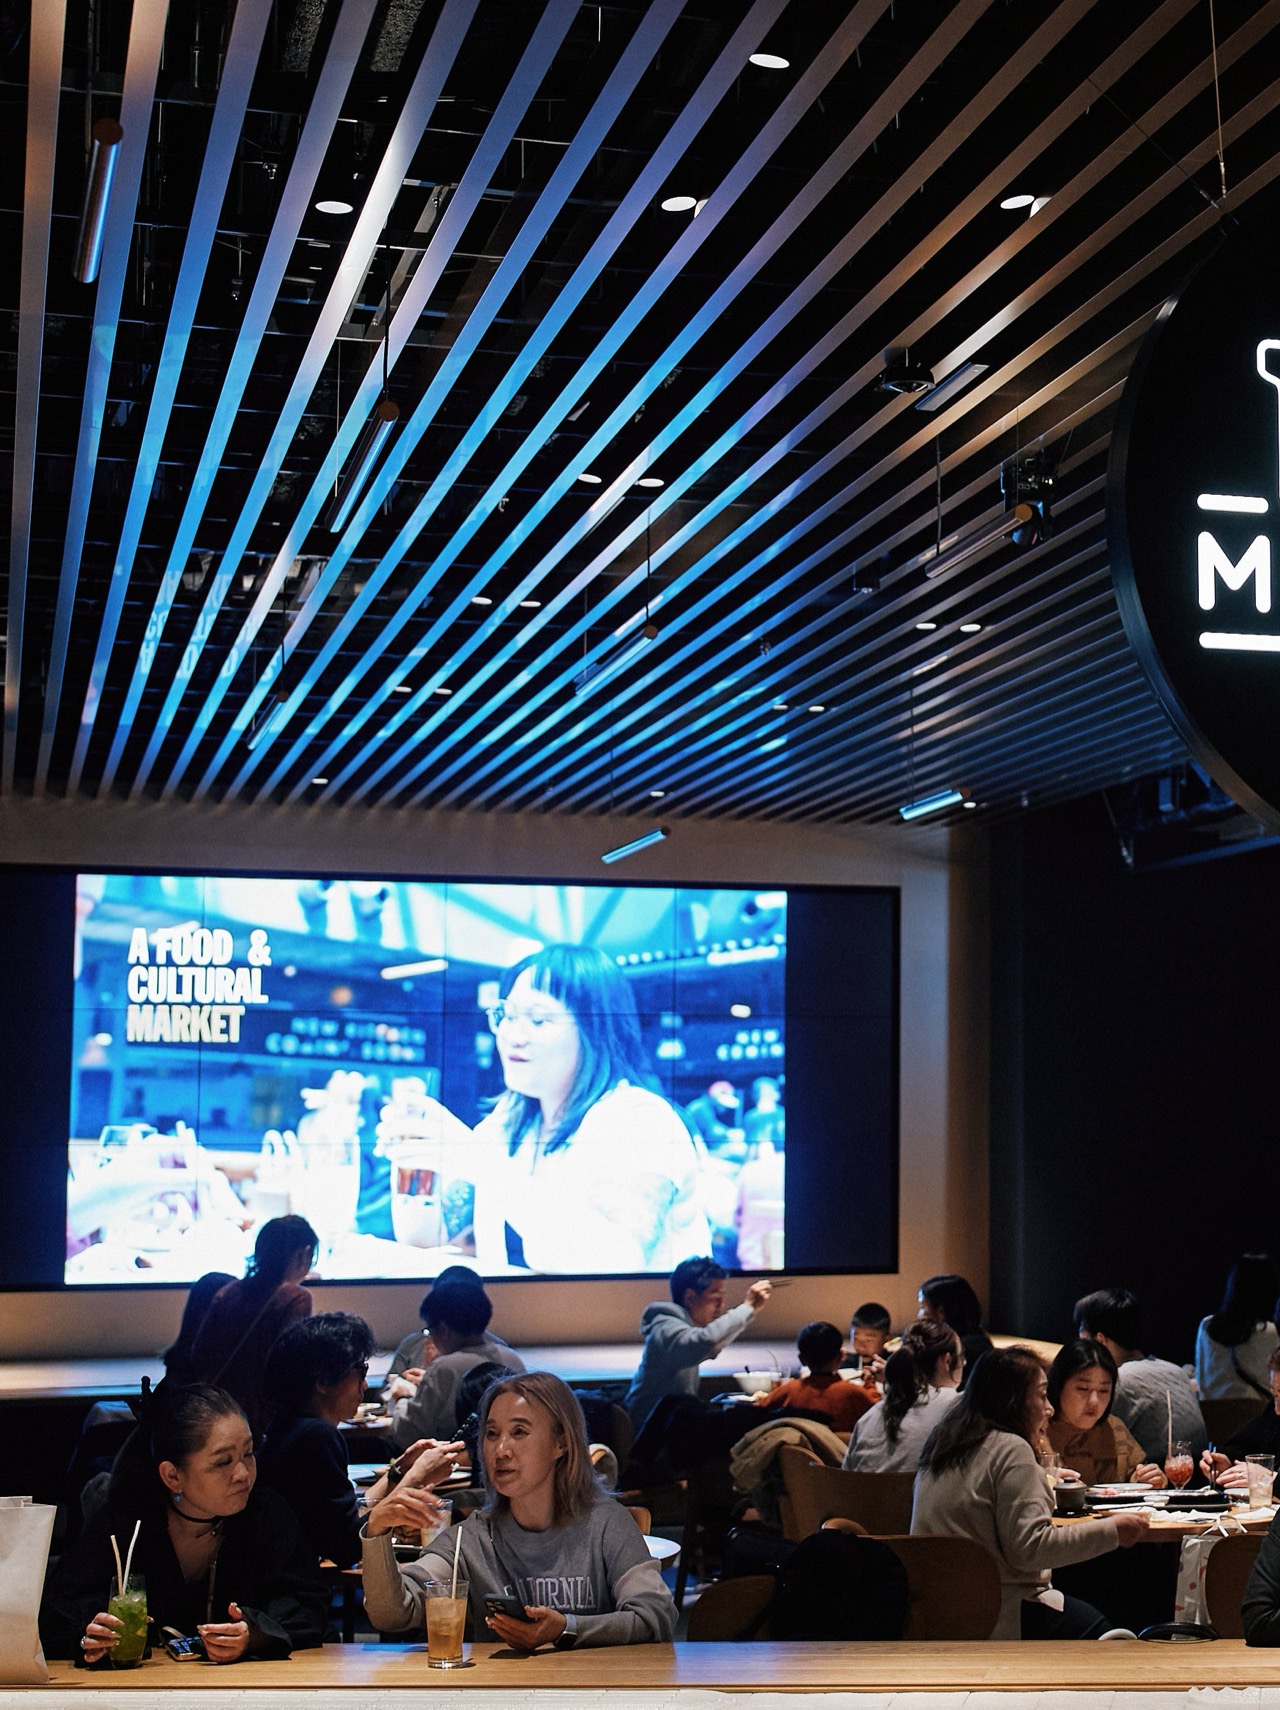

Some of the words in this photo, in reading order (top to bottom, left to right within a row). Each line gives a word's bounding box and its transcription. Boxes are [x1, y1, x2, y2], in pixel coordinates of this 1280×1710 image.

[127, 927, 149, 964] A
[155, 928, 234, 966] FOOD
[247, 929, 272, 966] &
[127, 965, 269, 1004] CULTURAL
[126, 1004, 245, 1043] MARKET
